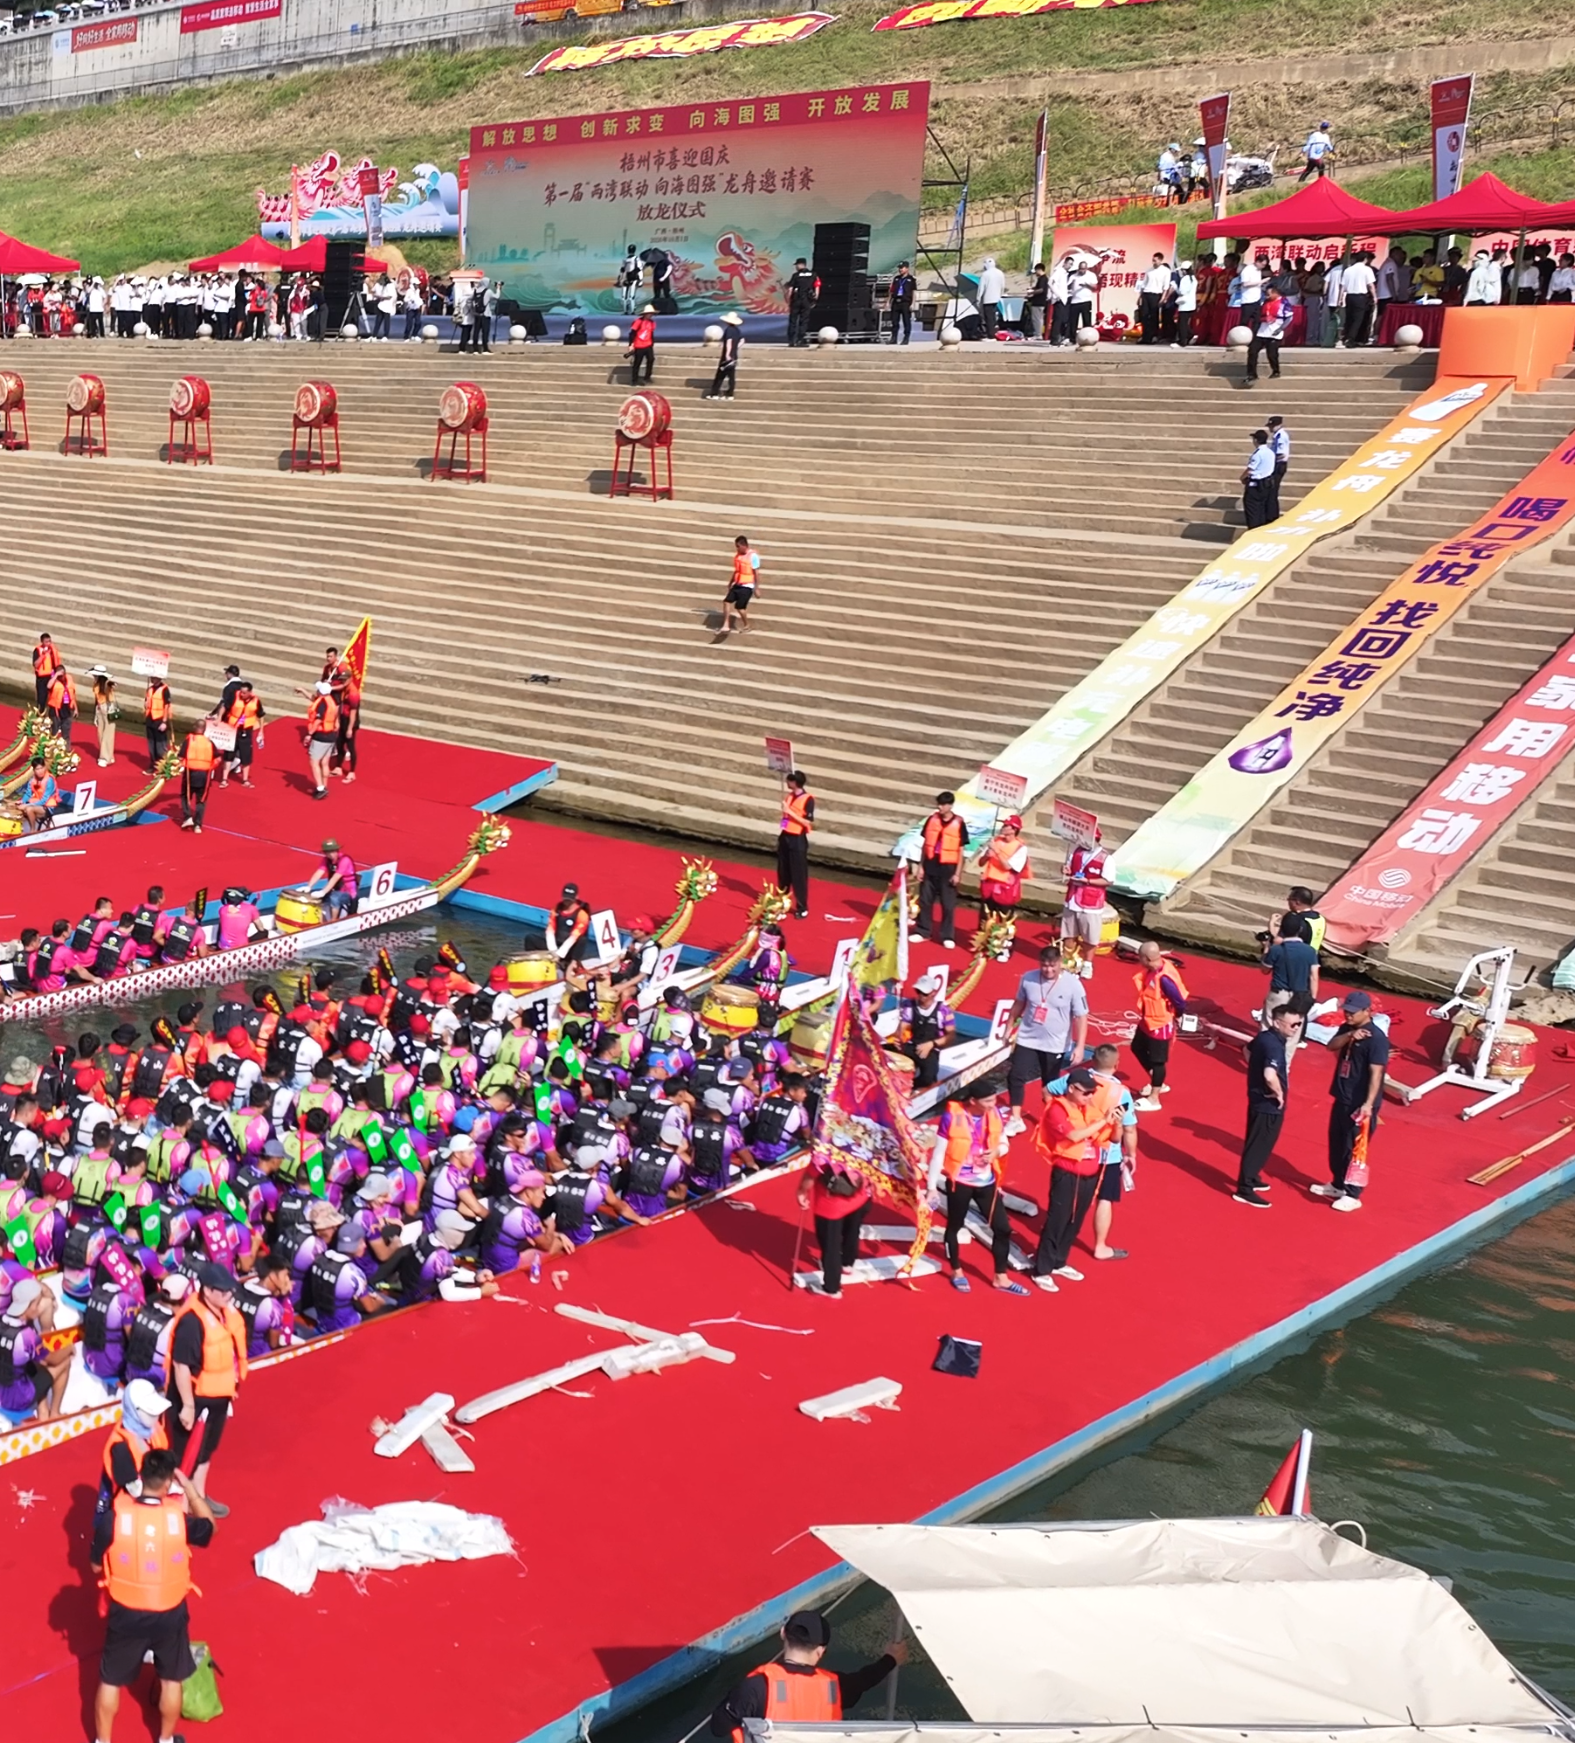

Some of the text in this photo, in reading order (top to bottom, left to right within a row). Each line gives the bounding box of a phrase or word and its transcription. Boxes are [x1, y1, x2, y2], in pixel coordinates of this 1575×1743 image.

[482, 89, 910, 148] 解放思想 创新求变 向海图强 开放发展
[620, 144, 730, 173] 梧州市喜迎国庆
[637, 201, 706, 220] 放龙仪式
[1491, 236, 1575, 256] 中国体育
[1331, 427, 1442, 493] 赛龙舟
[1273, 497, 1569, 721] 喝口纯悦 找回纯净
[1396, 654, 1575, 855] 家用移动
[80, 788, 92, 810] 7
[375, 869, 392, 895] 6
[1349, 885, 1413, 905] 中国移动
[601, 919, 616, 948] 4
[657, 954, 674, 982] 3
[995, 1008, 1011, 1041] 5
